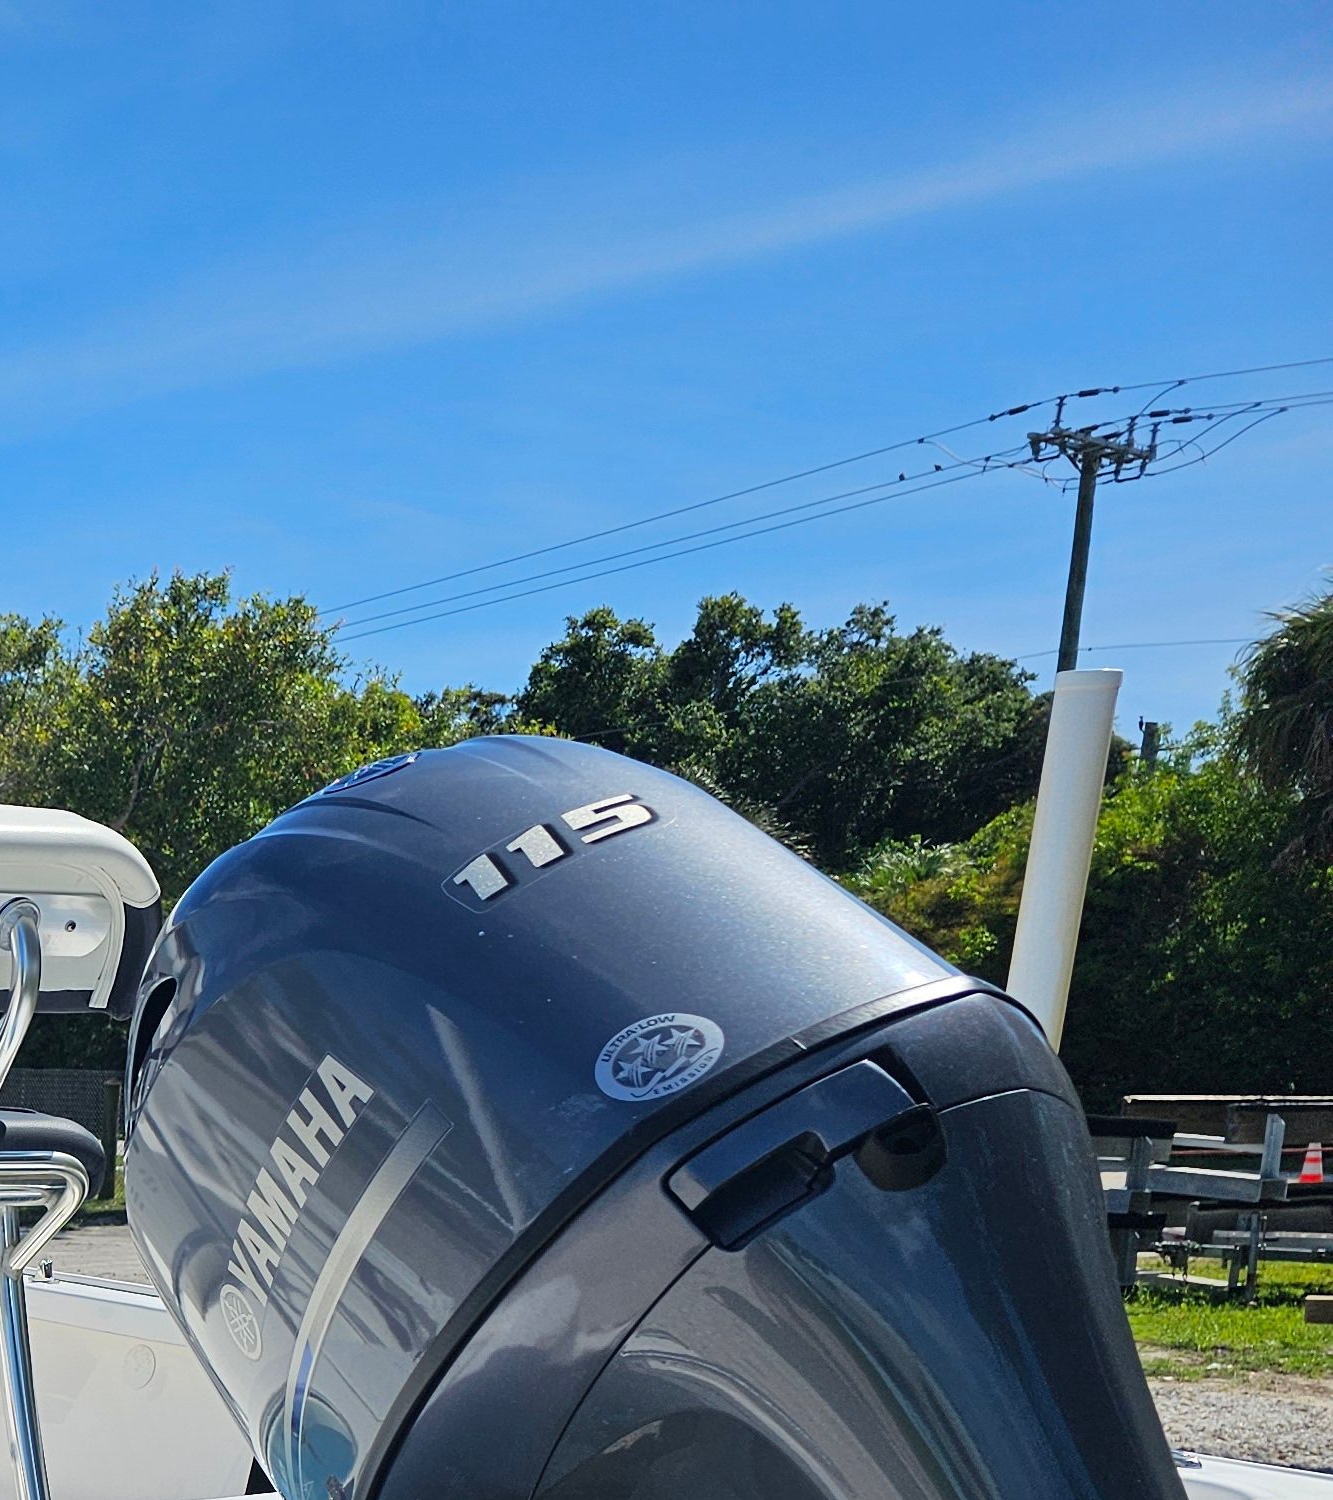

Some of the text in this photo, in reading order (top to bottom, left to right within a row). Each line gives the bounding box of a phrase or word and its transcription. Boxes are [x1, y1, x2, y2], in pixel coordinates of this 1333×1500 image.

[452, 793, 655, 901] 115
[652, 1055, 714, 1095] EMISSION
[228, 1054, 375, 1308] YAMAHA
